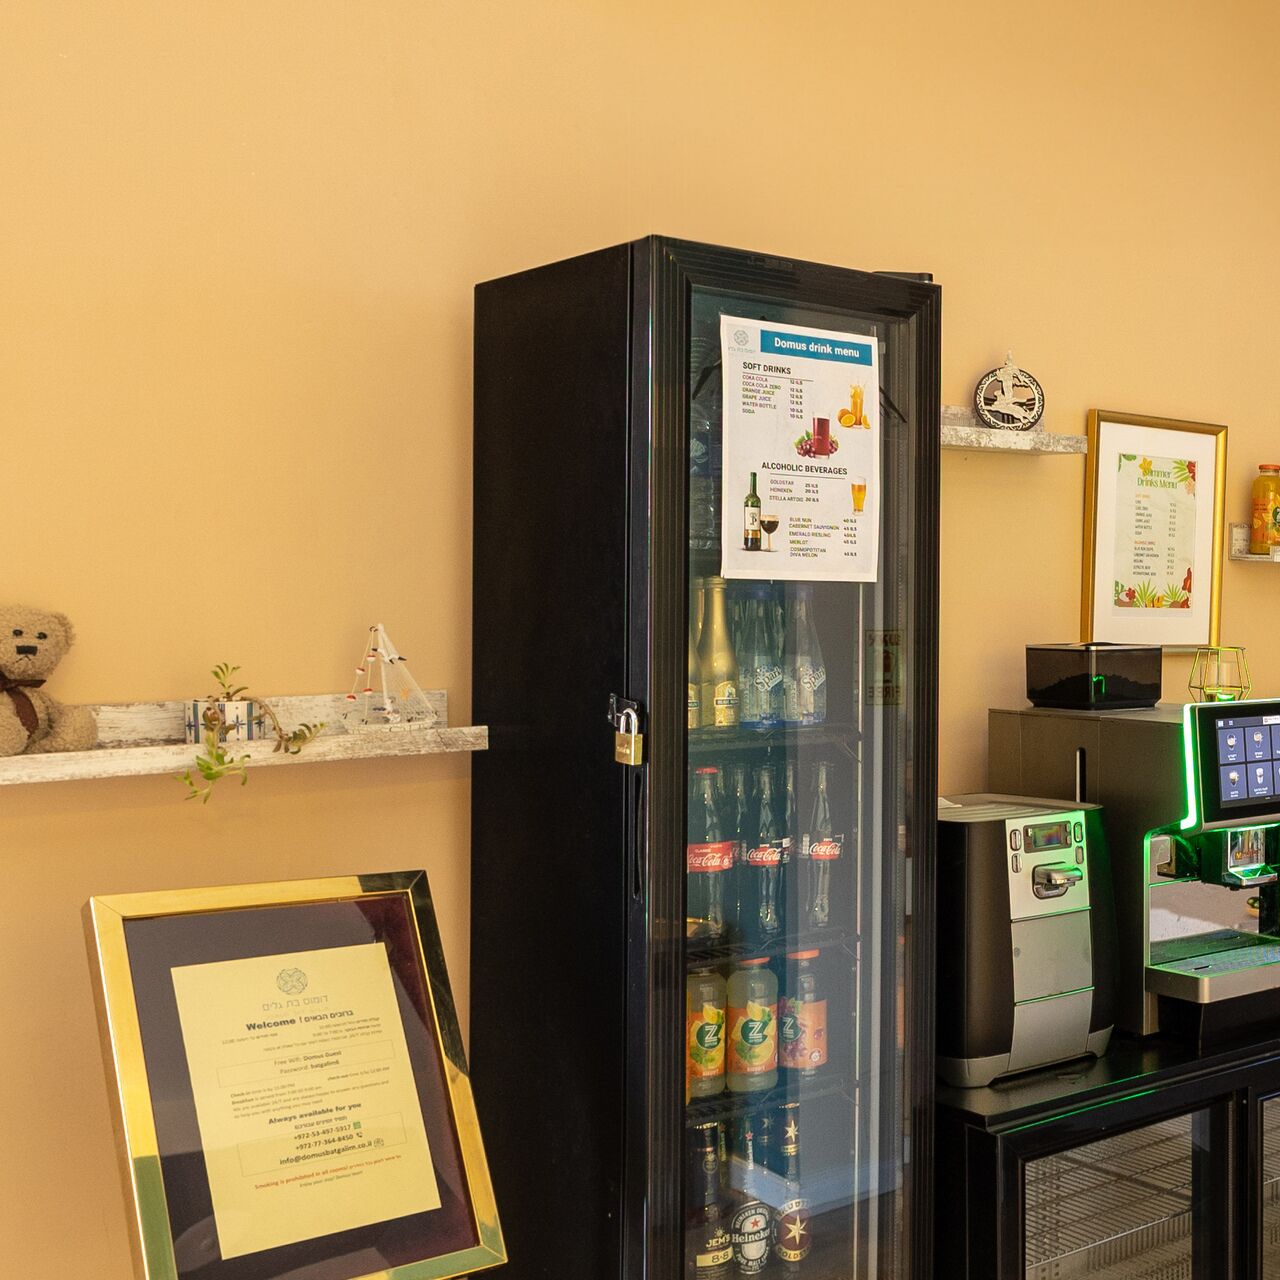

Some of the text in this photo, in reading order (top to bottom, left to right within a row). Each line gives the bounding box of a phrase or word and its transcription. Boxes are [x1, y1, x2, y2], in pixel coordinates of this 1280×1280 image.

[774, 337, 860, 358] Domus drink menu
[742, 361, 791, 375] SOFT DRINKS
[761, 462, 848, 476] ALCOHOLIC BEVERAGES
[245, 1018, 296, 1031] Welcome
[268, 1114, 297, 1125] Always
[299, 1107, 334, 1119] available
[348, 1102, 362, 1111] you
